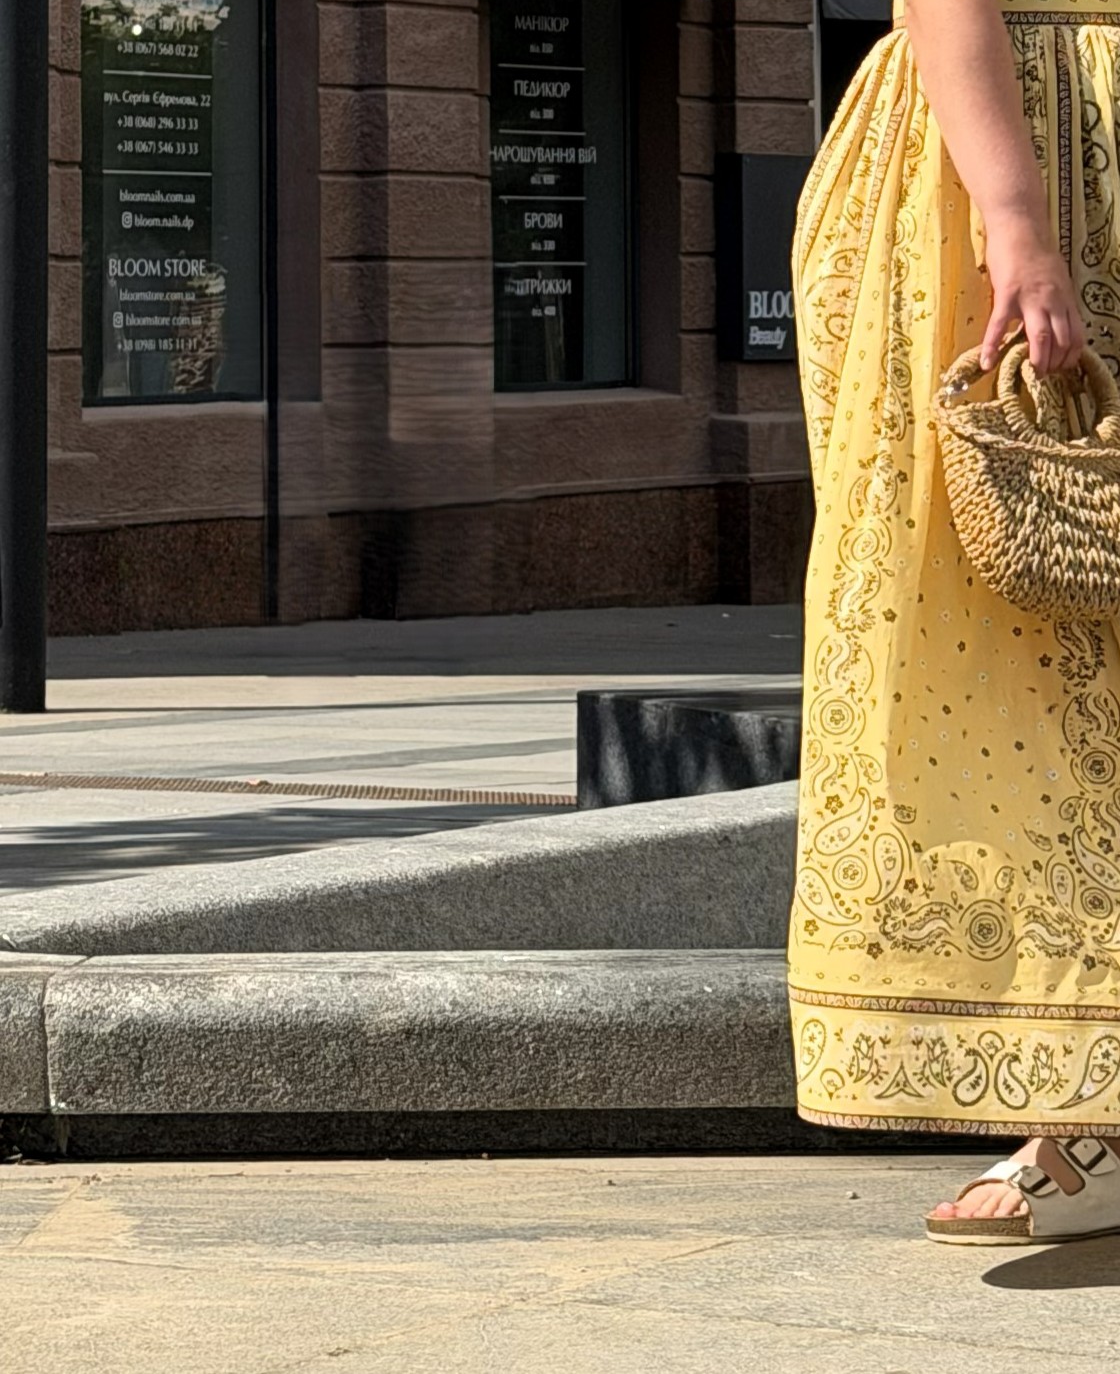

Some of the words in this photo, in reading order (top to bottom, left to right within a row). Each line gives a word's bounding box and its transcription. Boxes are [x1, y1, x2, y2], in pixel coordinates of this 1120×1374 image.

[514, 15, 570, 33] МАНІКЮР
[514, 79, 571, 98] ПЕДИКЮР
[200, 94, 211, 107] 22
[175, 117, 186, 130] 33
[188, 117, 199, 130] 33
[175, 142, 186, 155] 33
[188, 142, 199, 155] 33
[524, 212, 563, 229] БРОВИ
[108, 258, 161, 277] BLOOM
[164, 258, 206, 277] STORE
[748, 325, 787, 350] Beauty
